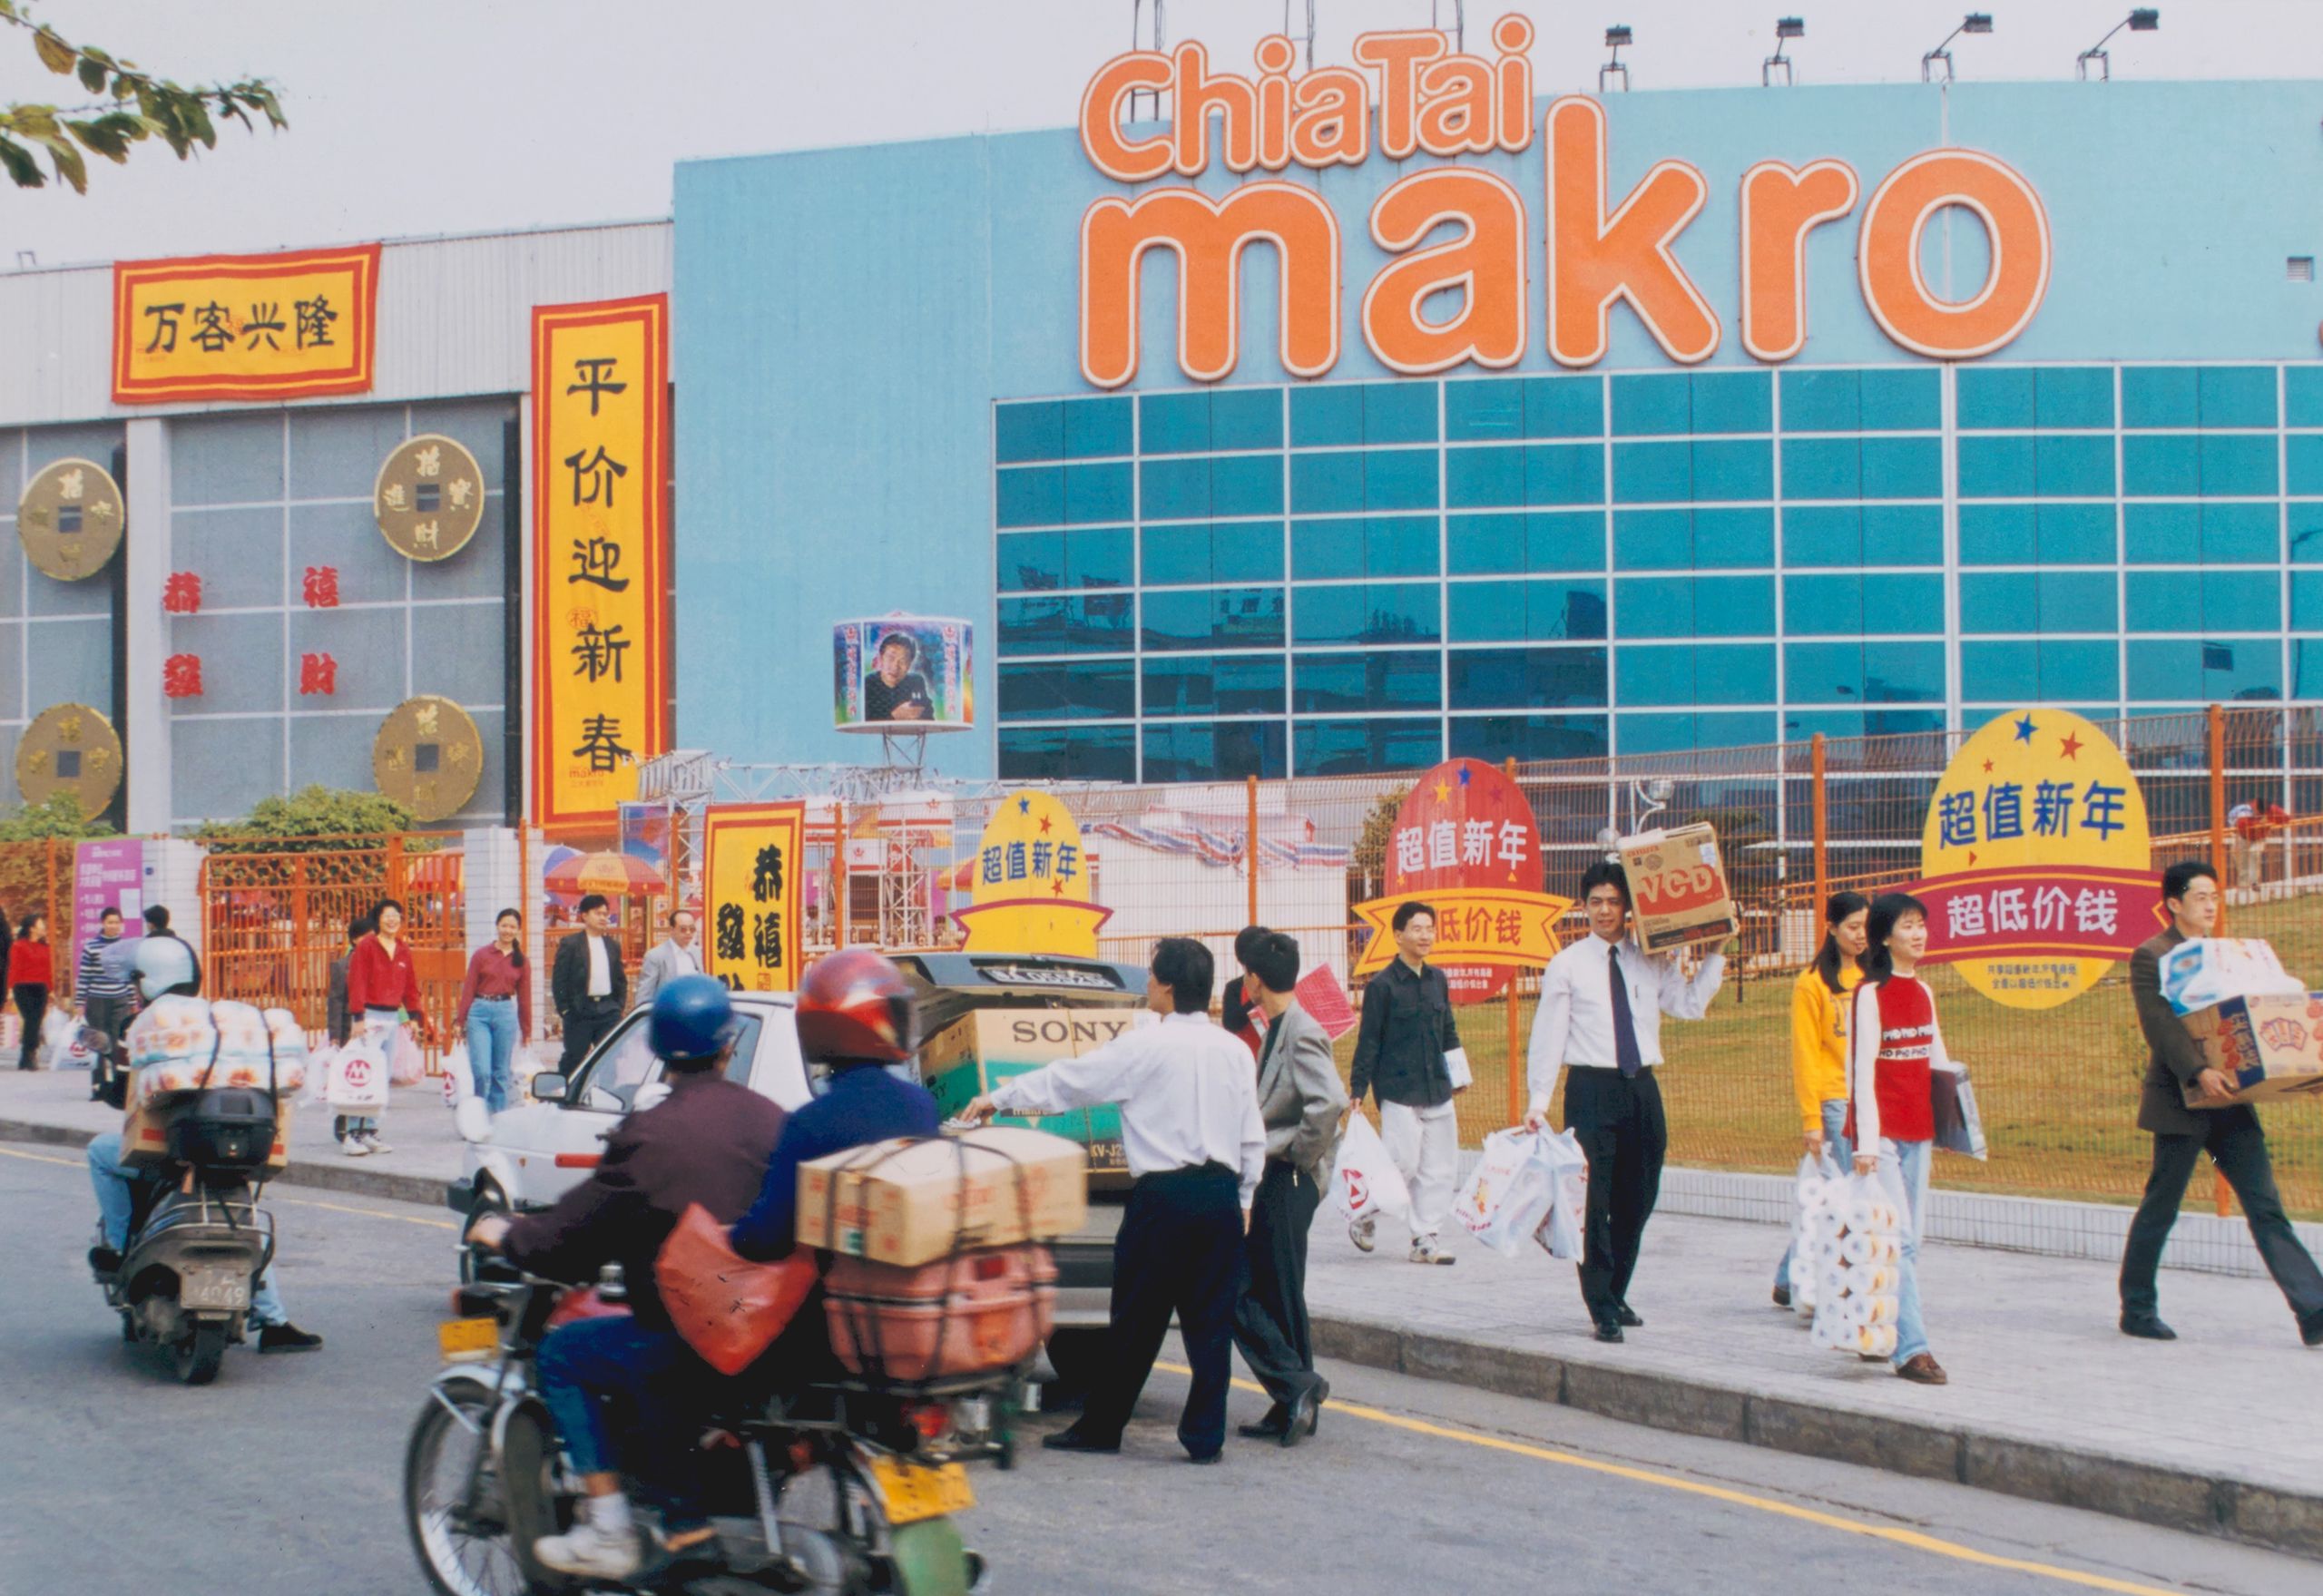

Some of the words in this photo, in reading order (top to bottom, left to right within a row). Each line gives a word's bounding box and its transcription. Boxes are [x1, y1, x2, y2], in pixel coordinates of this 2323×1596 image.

[1080, 94, 2052, 390] makro
[144, 293, 338, 353] 万客兴隆
[564, 357, 632, 773] 平价迎新春
[1939, 779, 2126, 849] 超值新年
[983, 839, 1077, 886] 超值新年
[1397, 817, 1527, 875] 超值新年
[1639, 865, 1714, 903] VCD
[1947, 886, 2118, 938] 超低价钱
[1013, 1020, 1127, 1043] SONY
